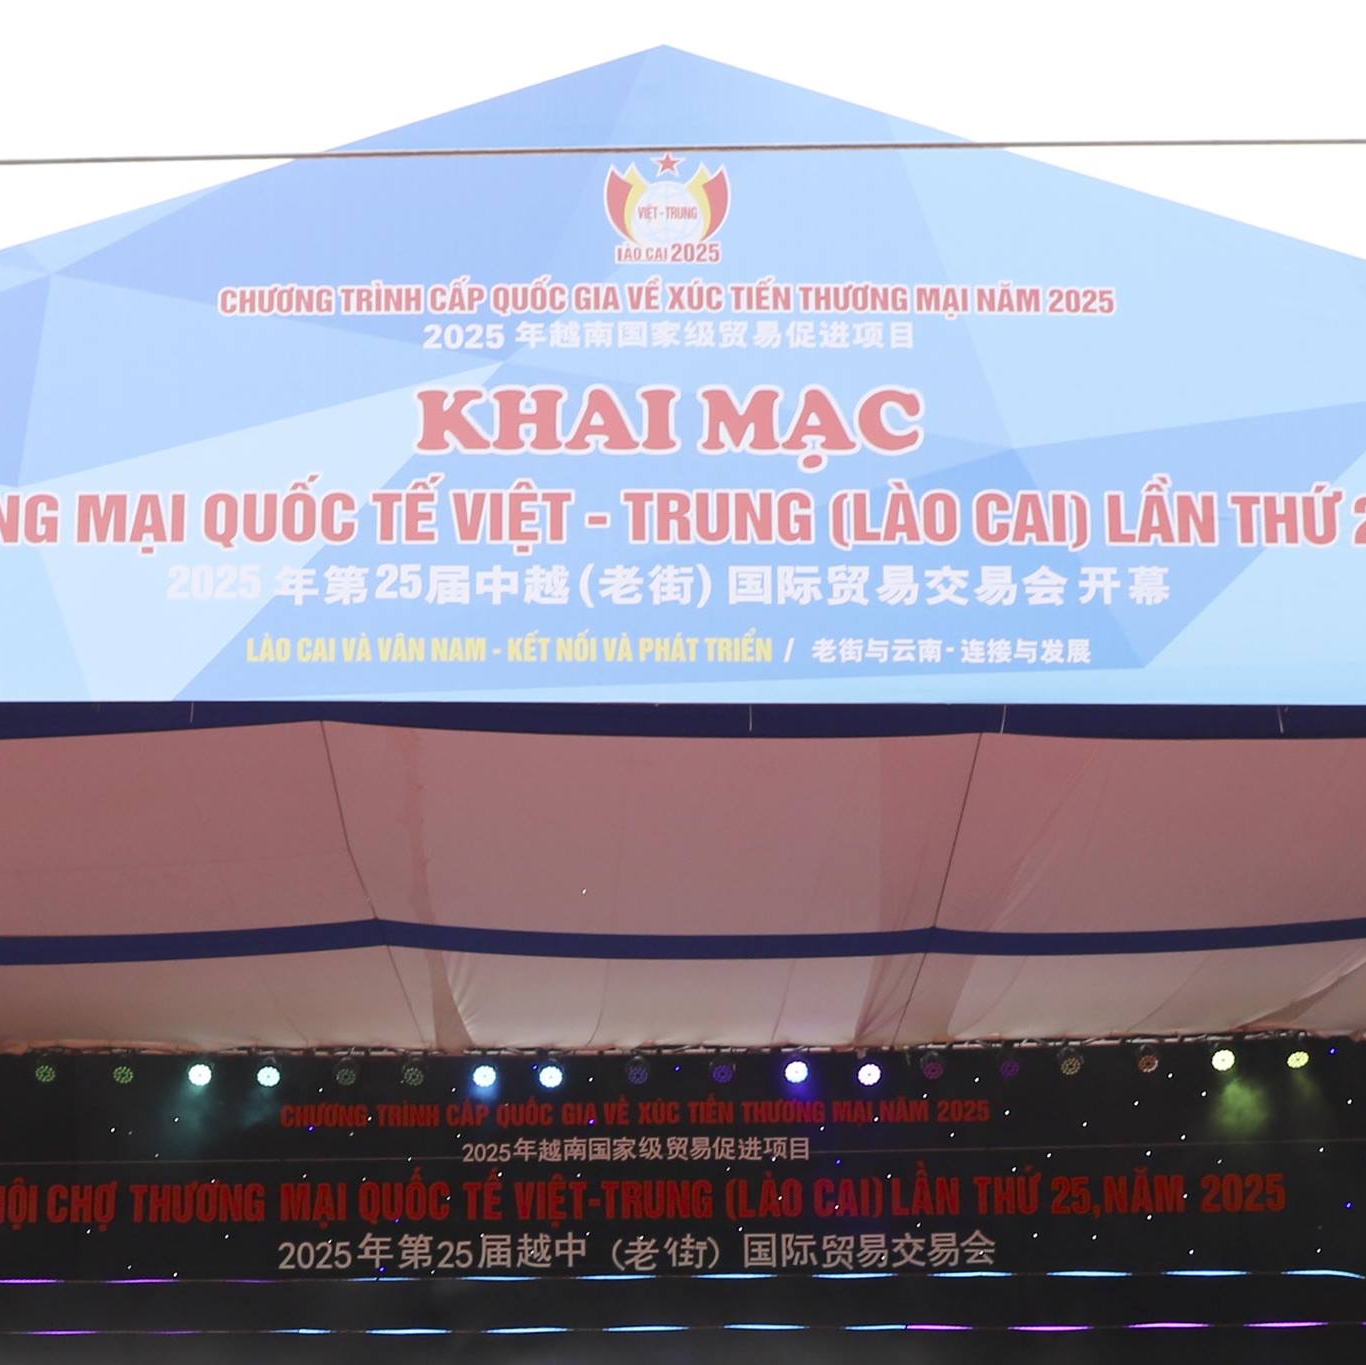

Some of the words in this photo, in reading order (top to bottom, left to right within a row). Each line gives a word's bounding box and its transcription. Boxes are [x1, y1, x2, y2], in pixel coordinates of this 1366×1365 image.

[666, 207, 698, 219] TRUNG
[645, 247, 667, 261] CAI
[671, 243, 719, 262] 2025
[220, 286, 333, 314] CHƯƠNG
[341, 281, 422, 312] TRÌNH
[429, 276, 484, 312] CẤP
[493, 276, 566, 315] QUỐC
[574, 287, 620, 311] GIA
[627, 279, 660, 311] VỀ
[668, 279, 722, 310] XÚC
[731, 277, 791, 311] TIẾN
[799, 285, 908, 312] THƯƠNG
[916, 287, 969, 318] MẠI
[977, 282, 1040, 312] NĂM
[1049, 289, 1114, 314] 2025
[424, 324, 504, 349] 2025
[417, 388, 678, 451] KHAI
[701, 389, 921, 469] MẠC
[77, 493, 185, 554] MẠI
[204, 474, 356, 548] QUỐC
[373, 474, 441, 542] TẾ
[452, 481, 572, 552] VIỆT
[623, 492, 812, 542] TRUNG
[834, 482, 958, 547] (LÀO
[975, 492, 1088, 548] CAI)
[1107, 476, 1215, 544] LẦN
[1232, 484, 1342, 545] THỨ
[166, 565, 261, 600] 2025
[247, 632, 291, 662] LÀO
[297, 638, 335, 662] CAI
[341, 632, 373, 662] VÀ
[378, 631, 425, 662] VÂN
[432, 637, 486, 662] NAM
[508, 629, 550, 662] KẾT
[556, 629, 597, 662] NỐI
[603, 632, 634, 662] VÀ
[639, 631, 699, 662] PHÁT
[705, 627, 772, 662] TRIỂN
[562, 1103, 597, 1126] GIA
[938, 1100, 990, 1123] 2025
[46, 1180, 118, 1231] CHỢ
[130, 1180, 265, 1224] THƯƠNG
[280, 1183, 347, 1229] MẠI
[358, 1165, 451, 1225] QUỐC
[463, 1171, 502, 1221] TẾ
[892, 1159, 960, 1216] LẦN
[1200, 1173, 1286, 1213] 2025
